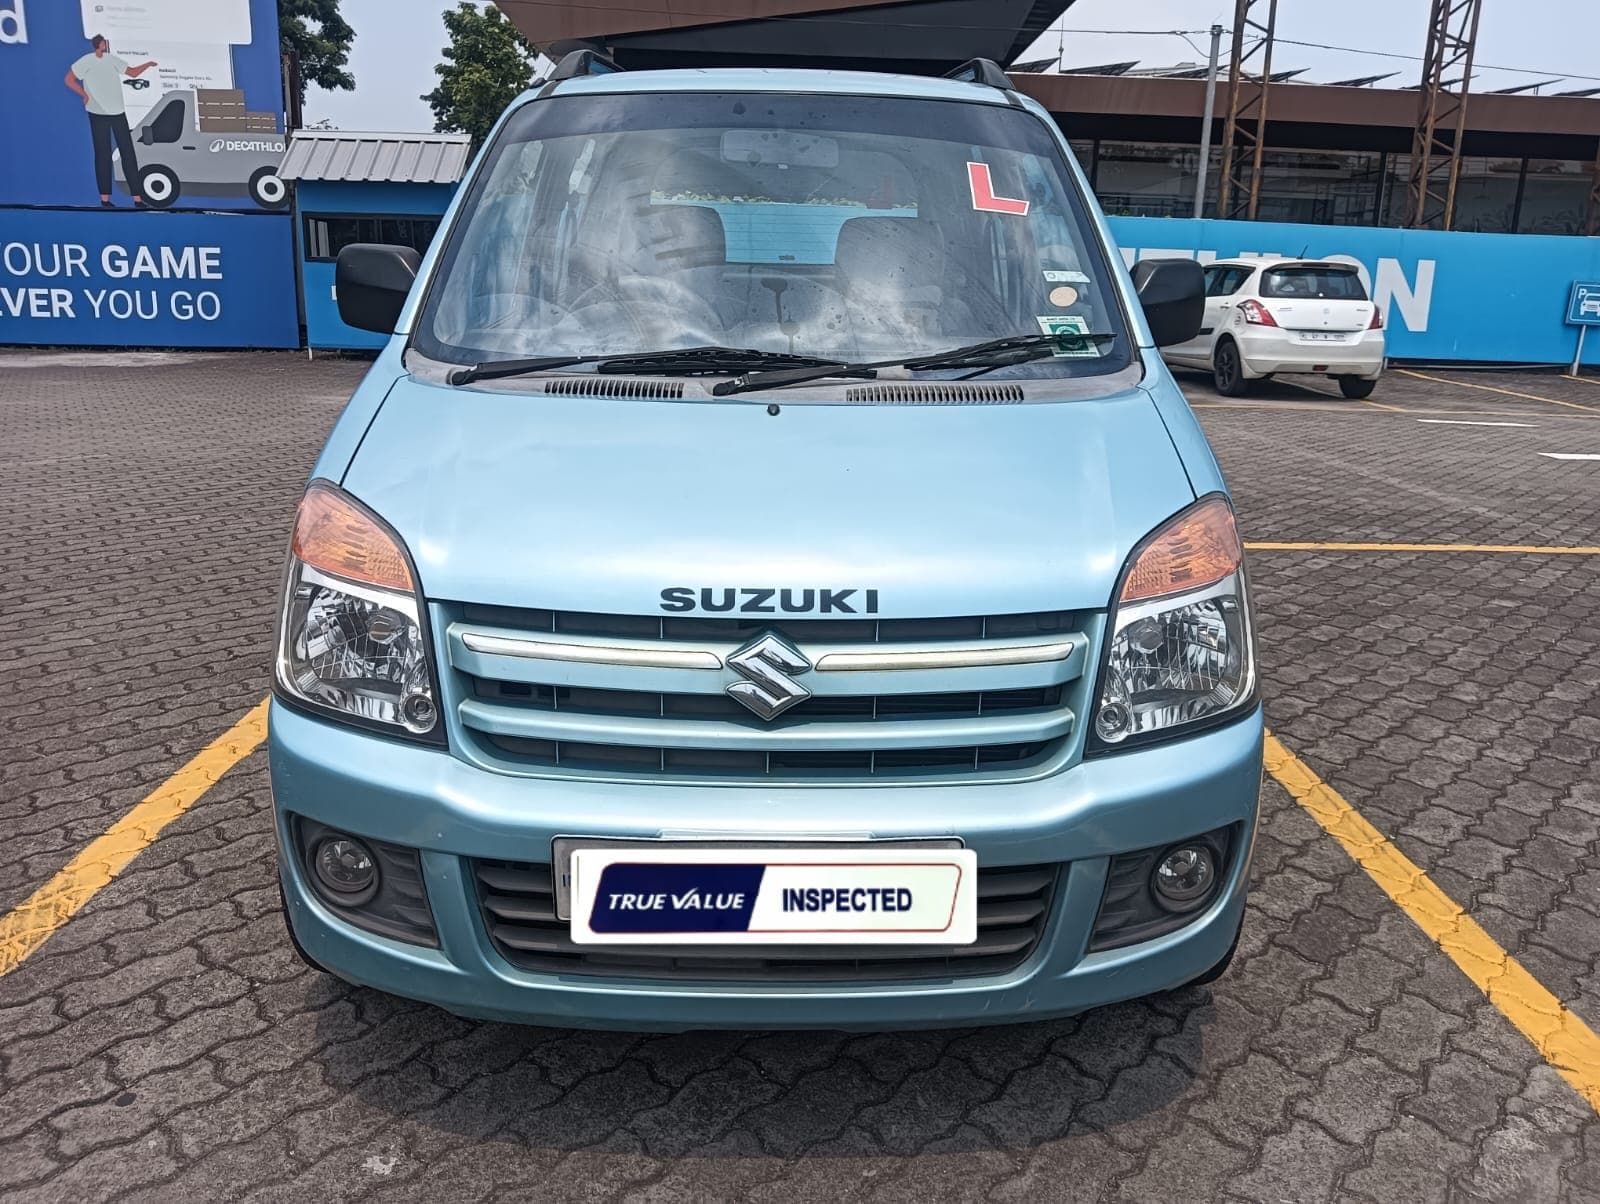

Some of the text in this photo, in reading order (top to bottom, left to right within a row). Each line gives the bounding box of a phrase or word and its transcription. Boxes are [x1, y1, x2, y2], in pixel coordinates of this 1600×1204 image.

[967, 161, 1030, 216] L
[0, 242, 223, 280] OUR GAME
[0, 287, 221, 321] VER YOU GO
[1578, 288, 1588, 299] P
[660, 587, 878, 614] SUZUKI
